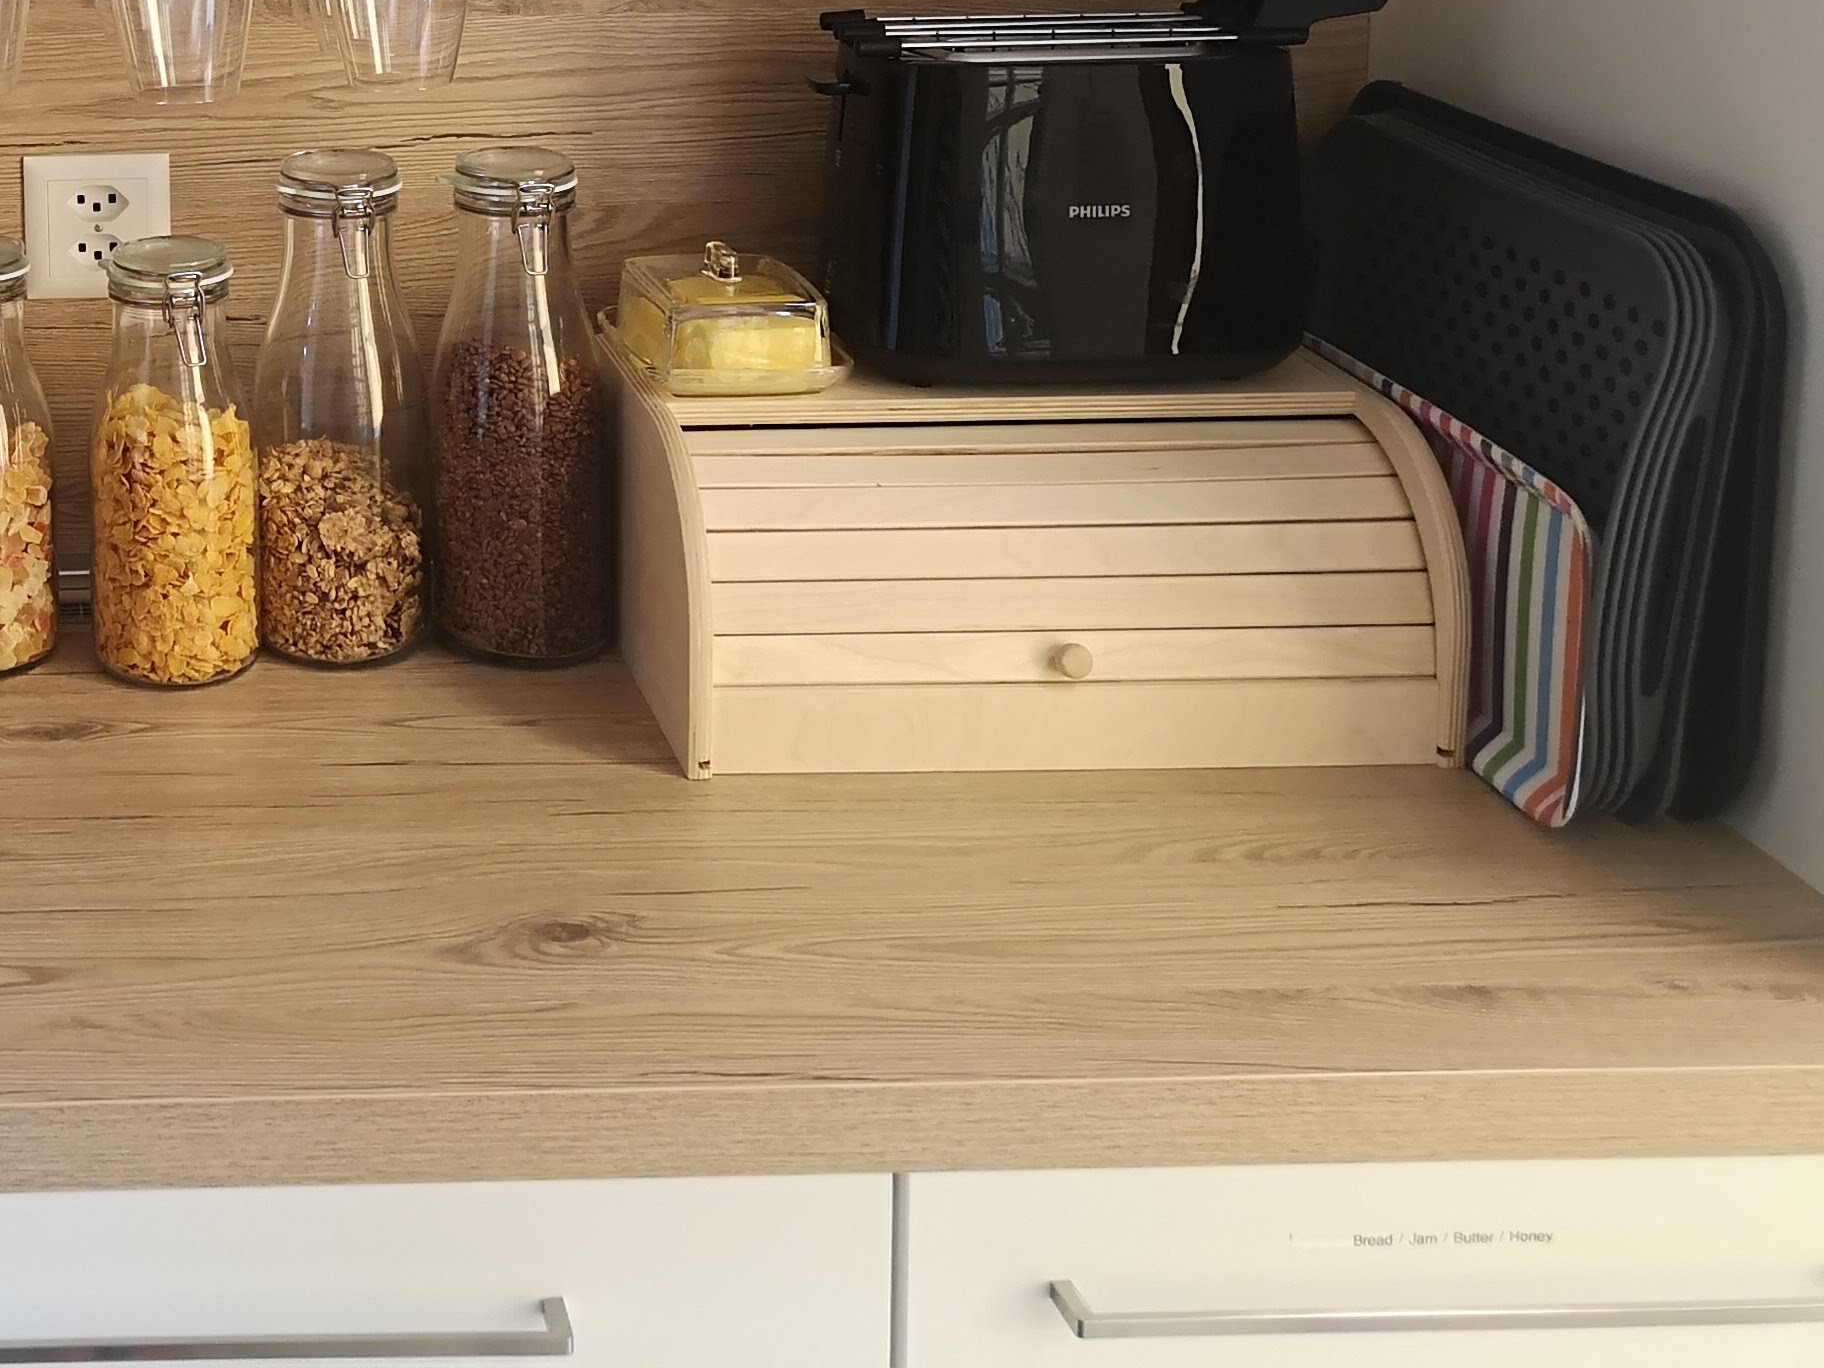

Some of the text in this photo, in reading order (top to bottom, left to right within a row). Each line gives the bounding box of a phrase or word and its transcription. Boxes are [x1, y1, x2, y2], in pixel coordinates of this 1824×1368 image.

[1068, 204, 1131, 219] PHILIPS
[1352, 1233, 1394, 1247] Bread
[1408, 1233, 1438, 1246] Jam
[1452, 1230, 1495, 1245] Butter
[1508, 1229, 1554, 1244] Honey
